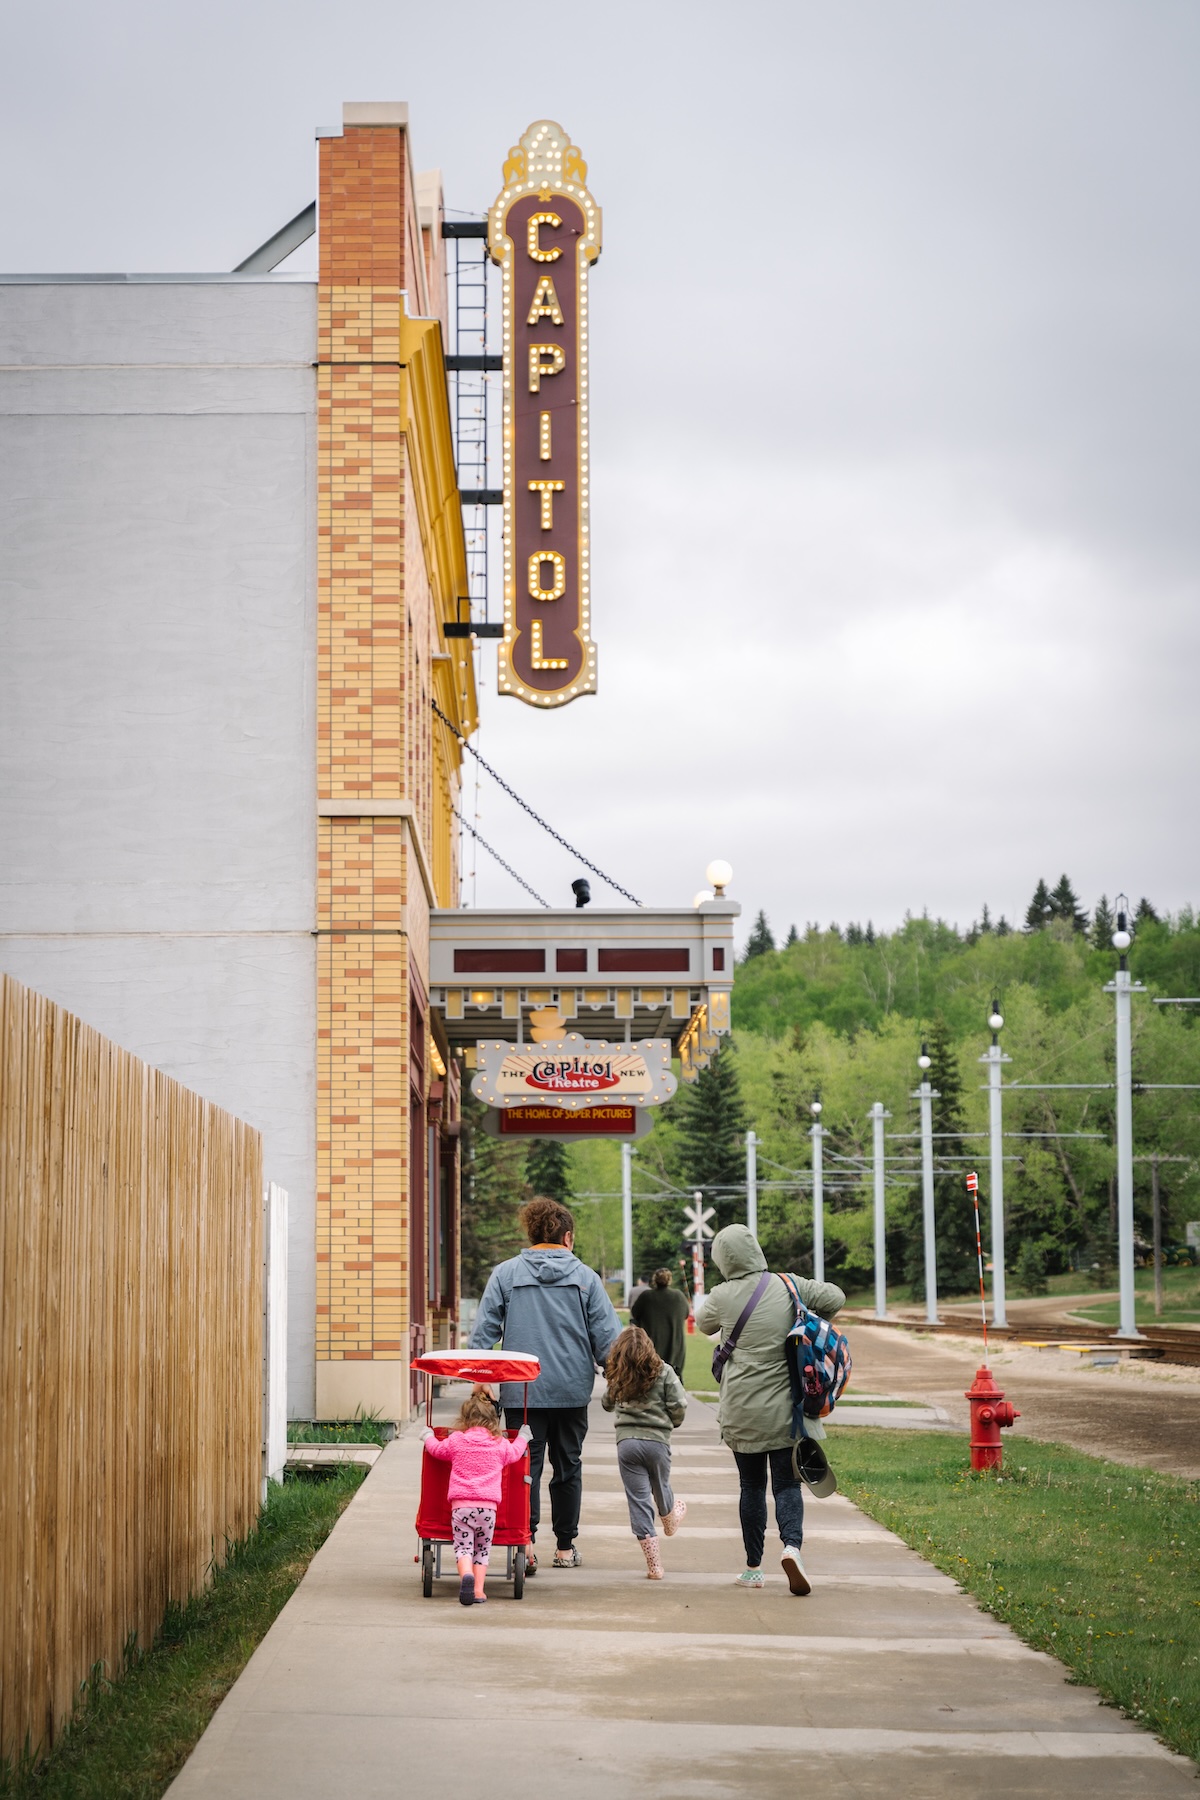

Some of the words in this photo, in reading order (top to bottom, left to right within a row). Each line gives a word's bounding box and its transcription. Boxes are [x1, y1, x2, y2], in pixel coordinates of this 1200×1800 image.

[526, 212, 569, 670] CAPITOL
[532, 1057, 614, 1082] Capitol
[547, 1078, 600, 1088] Theatre
[507, 1108, 523, 1119] THE
[525, 1108, 551, 1119] HOME
[552, 1108, 564, 1119] OF
[565, 1108, 591, 1119] SUPER
[592, 1108, 632, 1119] PICTURES
